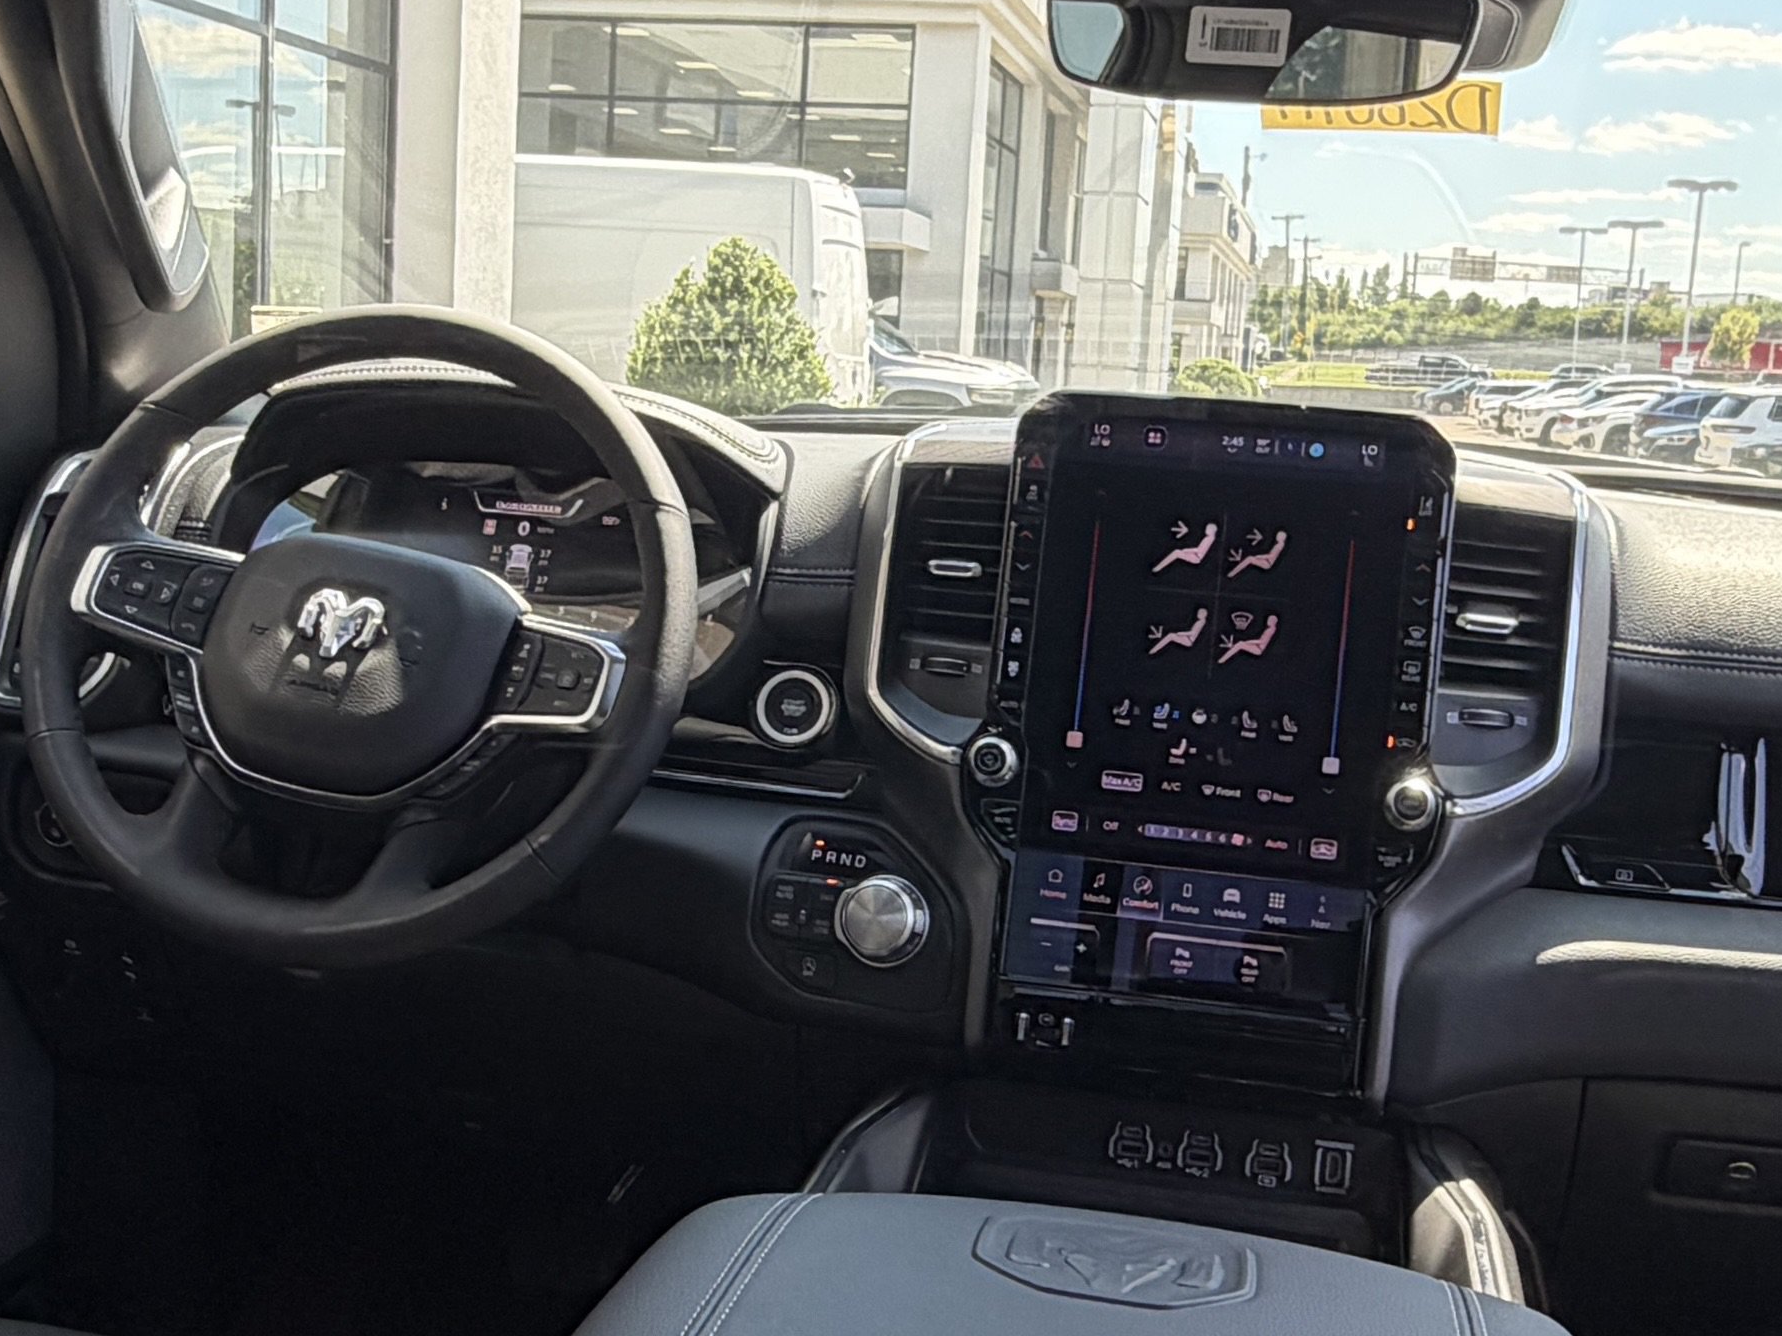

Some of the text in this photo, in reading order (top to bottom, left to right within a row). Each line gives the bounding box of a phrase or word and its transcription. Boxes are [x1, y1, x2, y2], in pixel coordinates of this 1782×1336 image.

[1161, 781, 1181, 792] A/C
[1170, 903, 1200, 915] Phone
[1262, 912, 1287, 926] Apps
